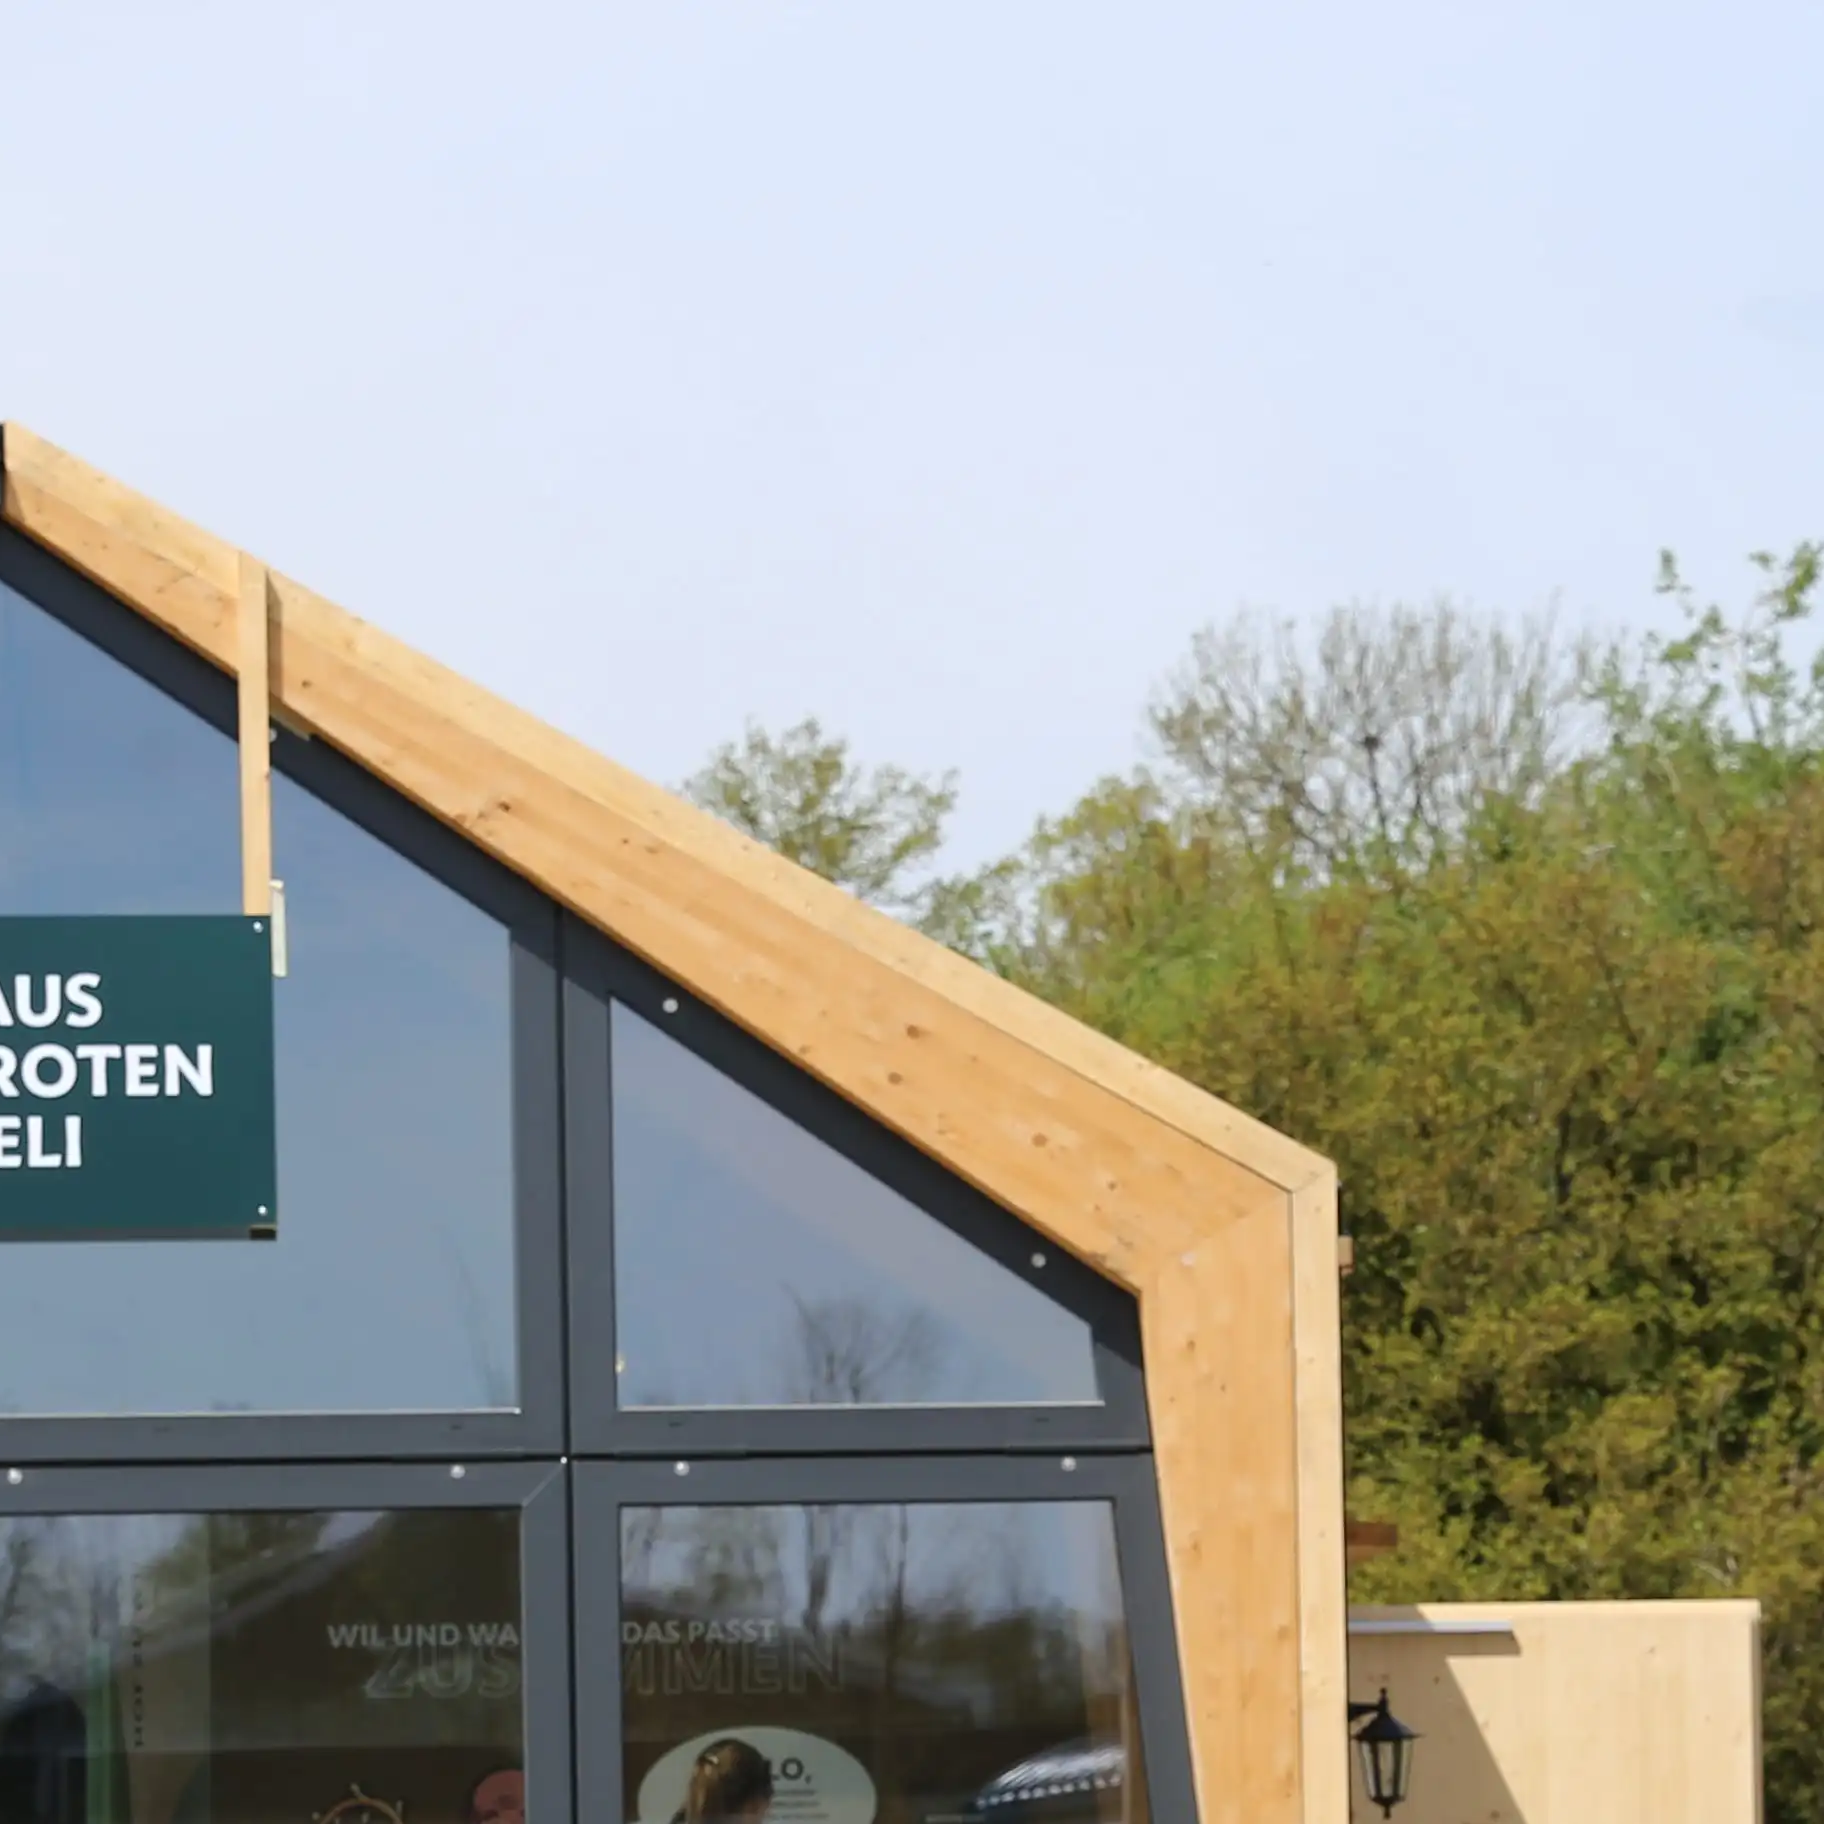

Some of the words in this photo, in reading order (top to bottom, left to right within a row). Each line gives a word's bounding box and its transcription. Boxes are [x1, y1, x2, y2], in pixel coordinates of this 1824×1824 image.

[327, 1622, 385, 1649] WIL
[391, 1622, 461, 1647] UND
[621, 1619, 681, 1645] DAS
[687, 1616, 778, 1644] PASST
